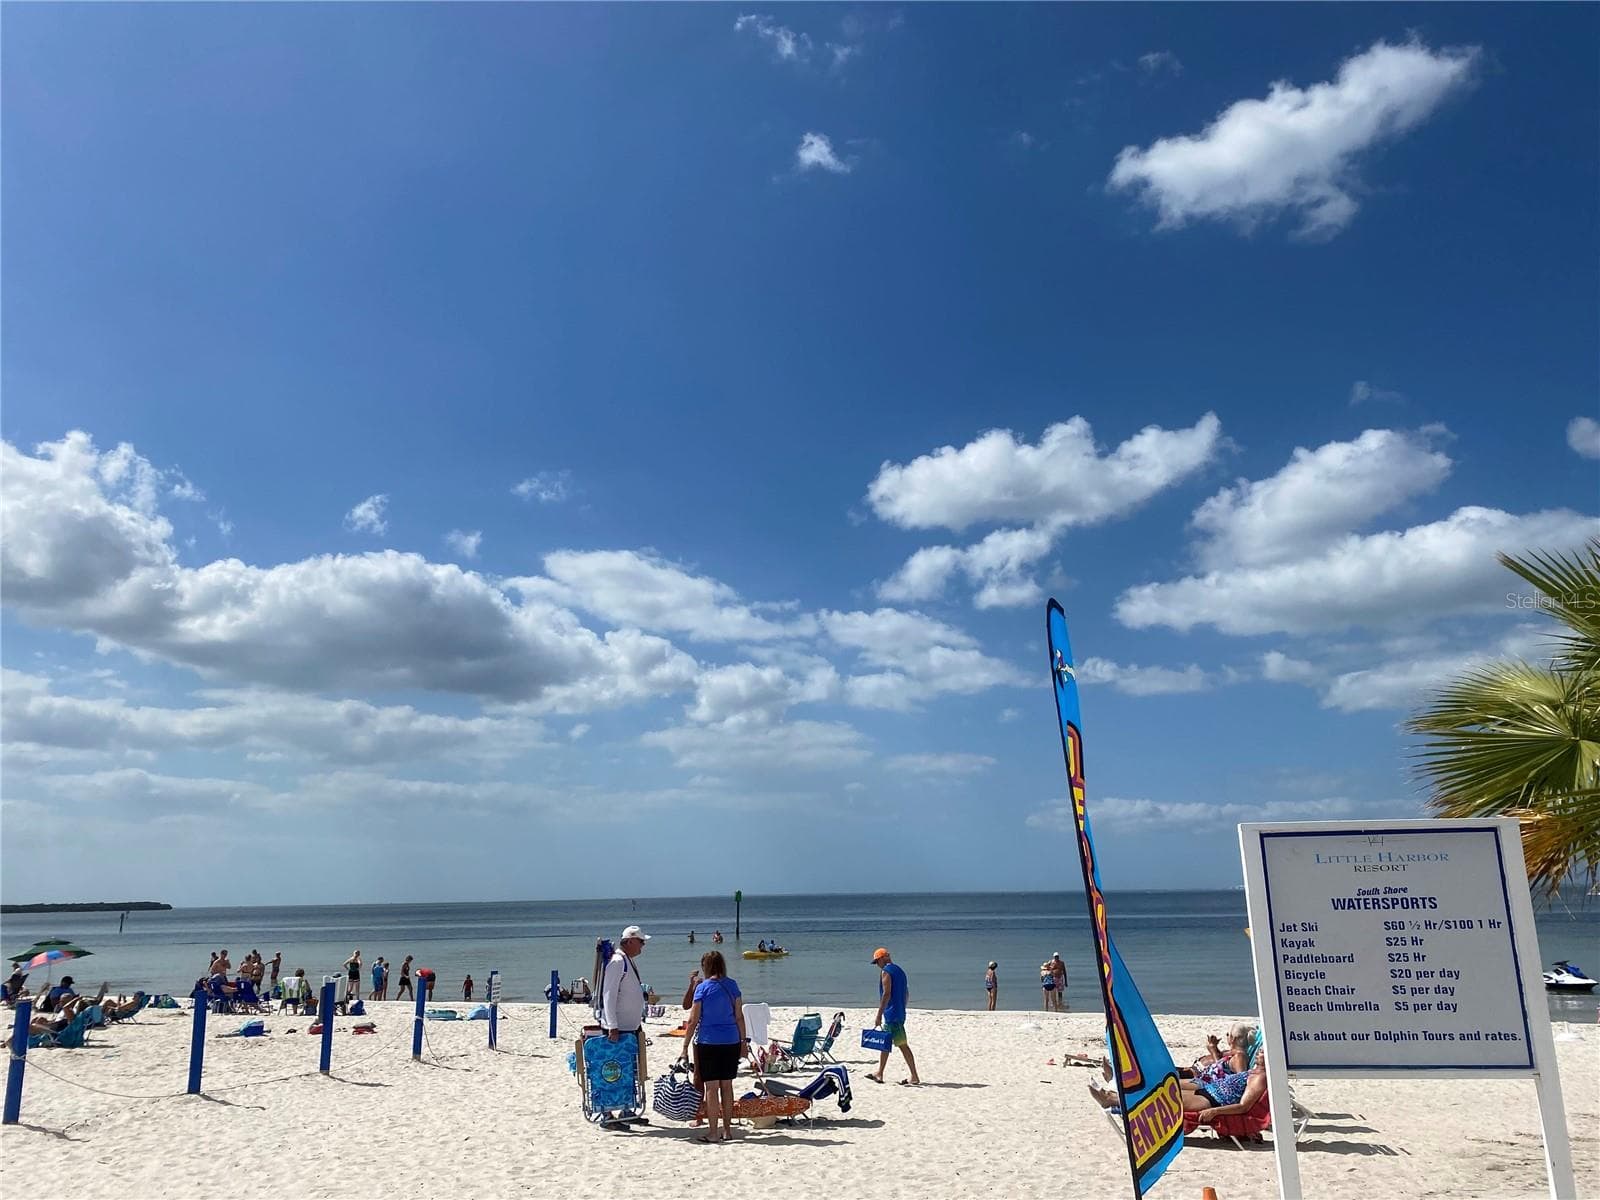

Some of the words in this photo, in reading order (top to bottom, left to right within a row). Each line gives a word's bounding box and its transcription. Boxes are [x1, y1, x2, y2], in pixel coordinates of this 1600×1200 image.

[1354, 864, 1408, 872] RESORT
[1357, 888, 1380, 896] South
[1331, 897, 1437, 910] WATERSPORTS
[1280, 923, 1298, 932] Jet
[1301, 922, 1318, 932] Ski
[1478, 920, 1483, 928] 1
[1488, 919, 1501, 928] Hr
[1281, 938, 1315, 949] Kayak
[1411, 936, 1424, 946] Hr
[1283, 953, 1354, 963] Paddleboard
[1413, 952, 1426, 962] Hr
[1285, 970, 1325, 981] Bicycle
[1416, 971, 1435, 980] per
[1439, 968, 1459, 980] day
[1287, 986, 1321, 995] Beach
[1325, 985, 1355, 995] Chair
[1411, 987, 1430, 996] per
[1434, 984, 1454, 996] day
[1288, 1002, 1323, 1011] Beach
[1327, 1001, 1379, 1011] Umbrella
[1413, 1003, 1432, 1013] per
[1437, 1001, 1457, 1012] day
[1290, 1031, 1310, 1041] Ask
[1314, 1031, 1347, 1041] about
[1374, 1031, 1418, 1043] Dolphin
[1422, 1031, 1454, 1040] Tours
[1459, 1031, 1481, 1040] and
[1485, 1032, 1521, 1041] rates.
[1129, 1080, 1181, 1161] ENTALS
